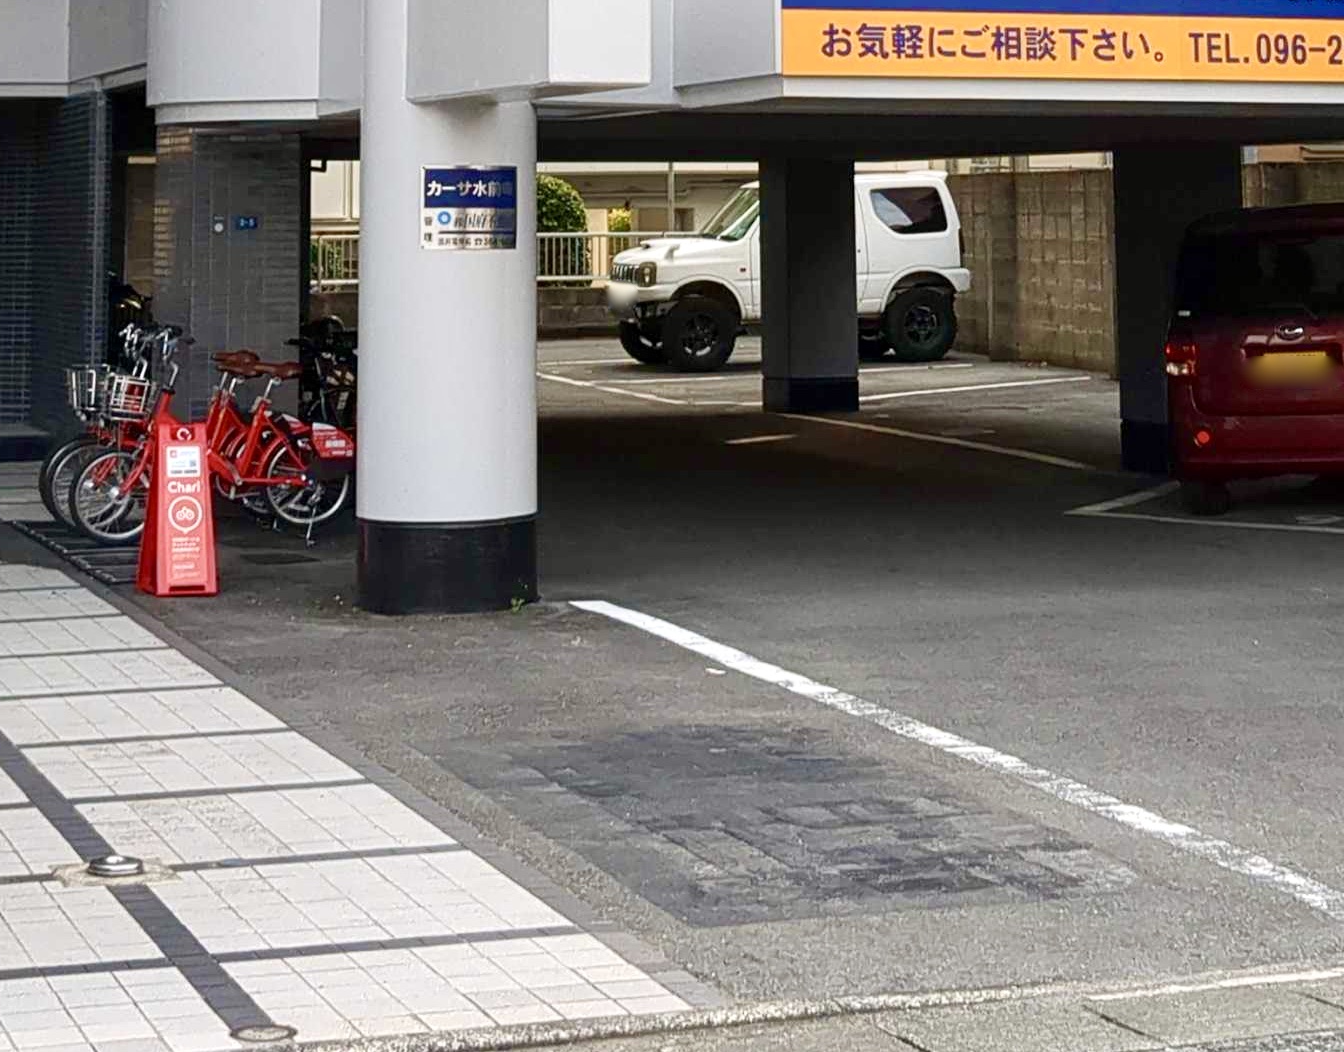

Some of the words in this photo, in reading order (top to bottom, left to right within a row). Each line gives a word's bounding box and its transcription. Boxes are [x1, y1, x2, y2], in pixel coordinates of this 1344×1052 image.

[821, 22, 1165, 63] お気軽にご相談下さい。
